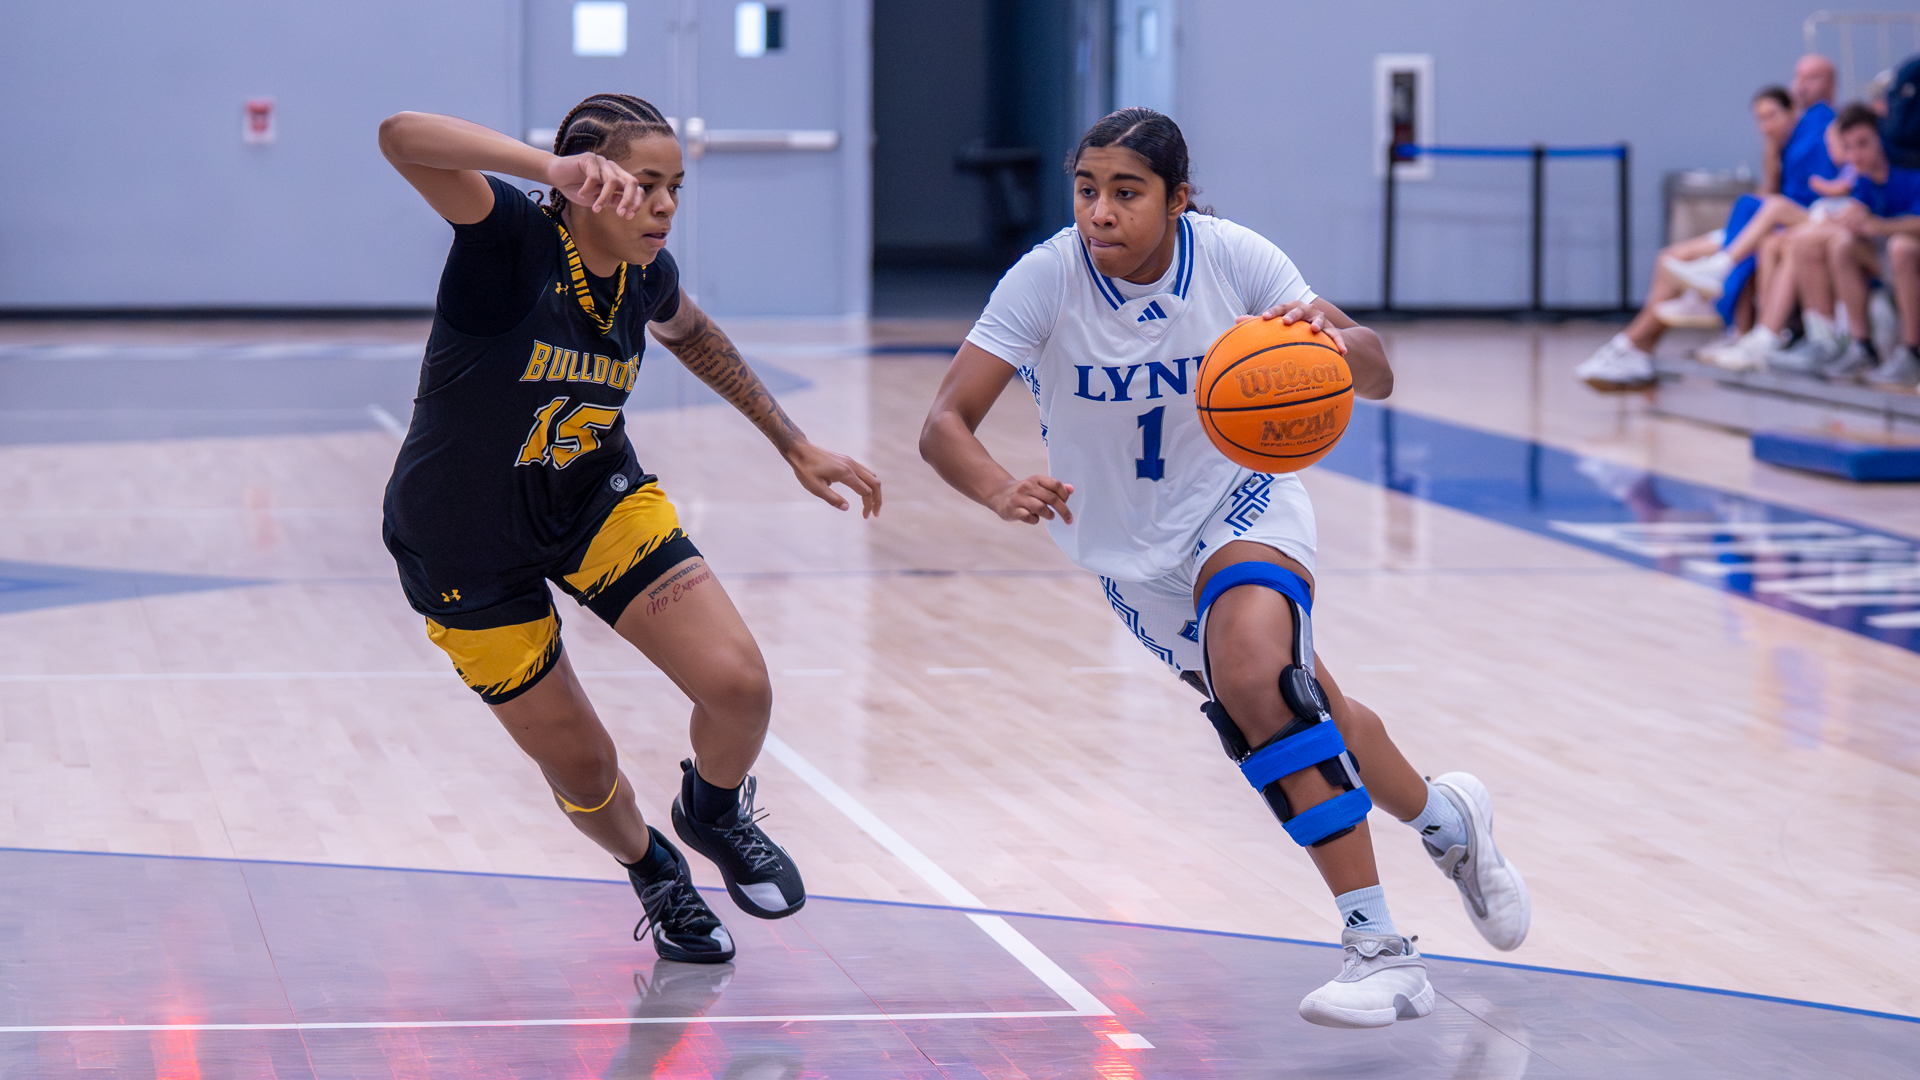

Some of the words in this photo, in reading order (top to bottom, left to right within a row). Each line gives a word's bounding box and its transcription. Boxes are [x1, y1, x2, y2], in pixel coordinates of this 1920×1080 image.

[1073, 355, 1206, 402] LYN
[1235, 359, 1342, 399] Wilson
[514, 396, 622, 470] 15
[1135, 405, 1166, 482] 1
[1261, 408, 1336, 442] NCAA
